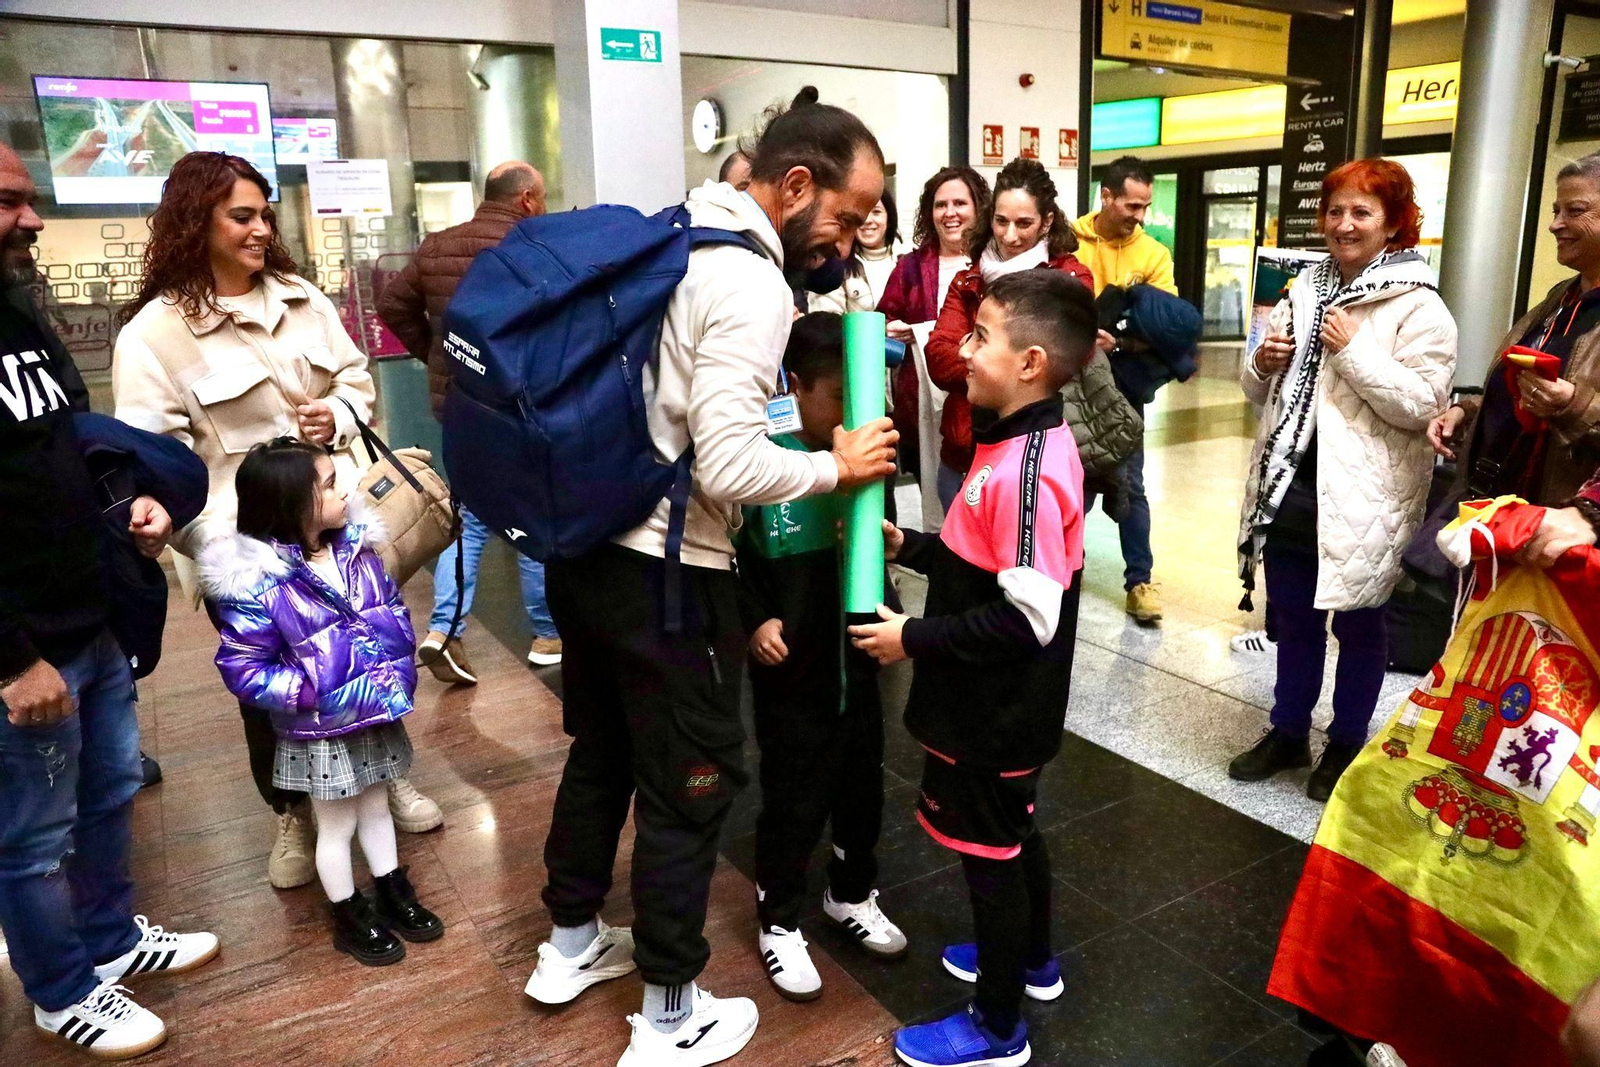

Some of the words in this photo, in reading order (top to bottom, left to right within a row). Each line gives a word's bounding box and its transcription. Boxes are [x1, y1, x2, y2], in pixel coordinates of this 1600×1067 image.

[1148, 33, 1177, 47] Alquiler
[1179, 38, 1188, 47] de
[1190, 40, 1213, 52] coches
[1287, 121, 1313, 131] RENT
[1314, 120, 1322, 128] A
[1322, 117, 1344, 128] CAR
[1298, 161, 1326, 173] Hertz
[1298, 197, 1322, 209] AVIS
[1288, 217, 1317, 226] enterp
[54, 316, 107, 339] enfe
[448, 331, 480, 359] ESPAÑA
[443, 339, 486, 376] ATLETISMO
[1022, 529, 1032, 567] KEDE
